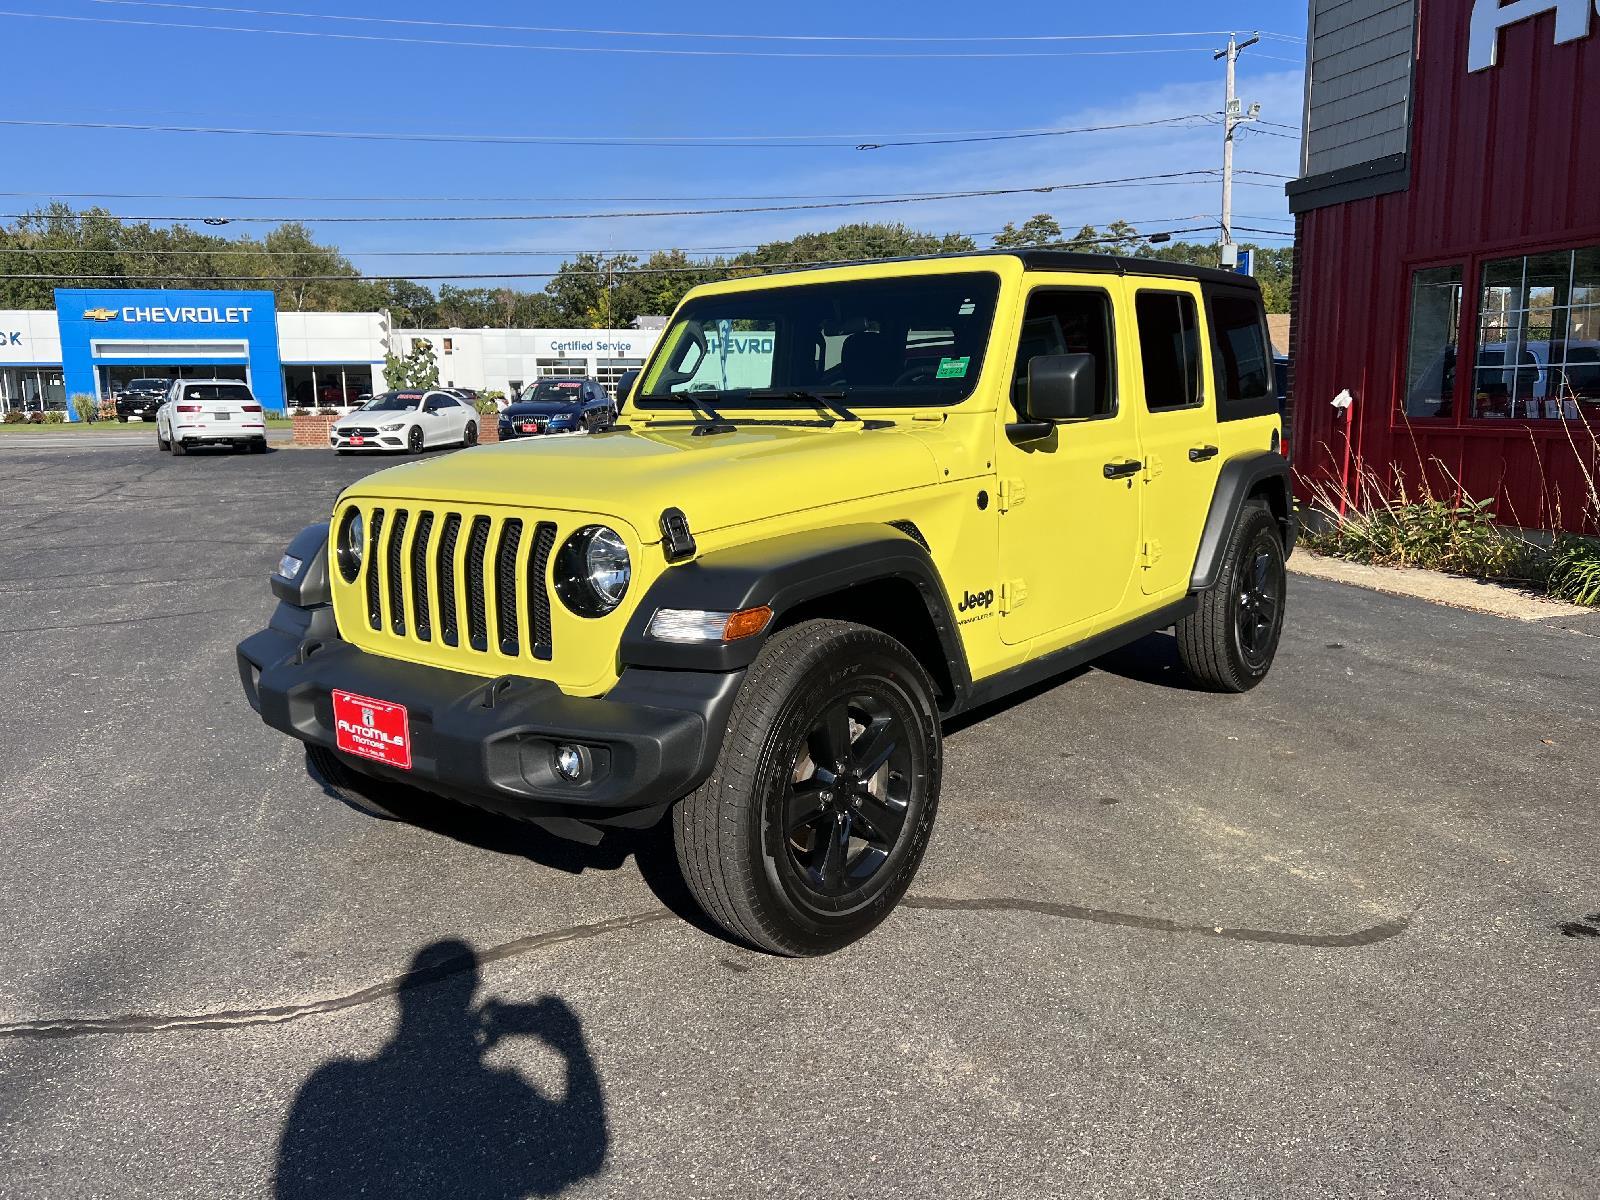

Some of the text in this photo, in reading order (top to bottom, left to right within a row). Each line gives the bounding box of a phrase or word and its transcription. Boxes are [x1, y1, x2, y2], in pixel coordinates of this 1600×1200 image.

[1468, 0, 1600, 73] A
[122, 307, 253, 323] CHEVROLET
[550, 340, 632, 351] Certified Service
[958, 589, 994, 612] Jeep
[338, 719, 404, 746] AUTOMILE
